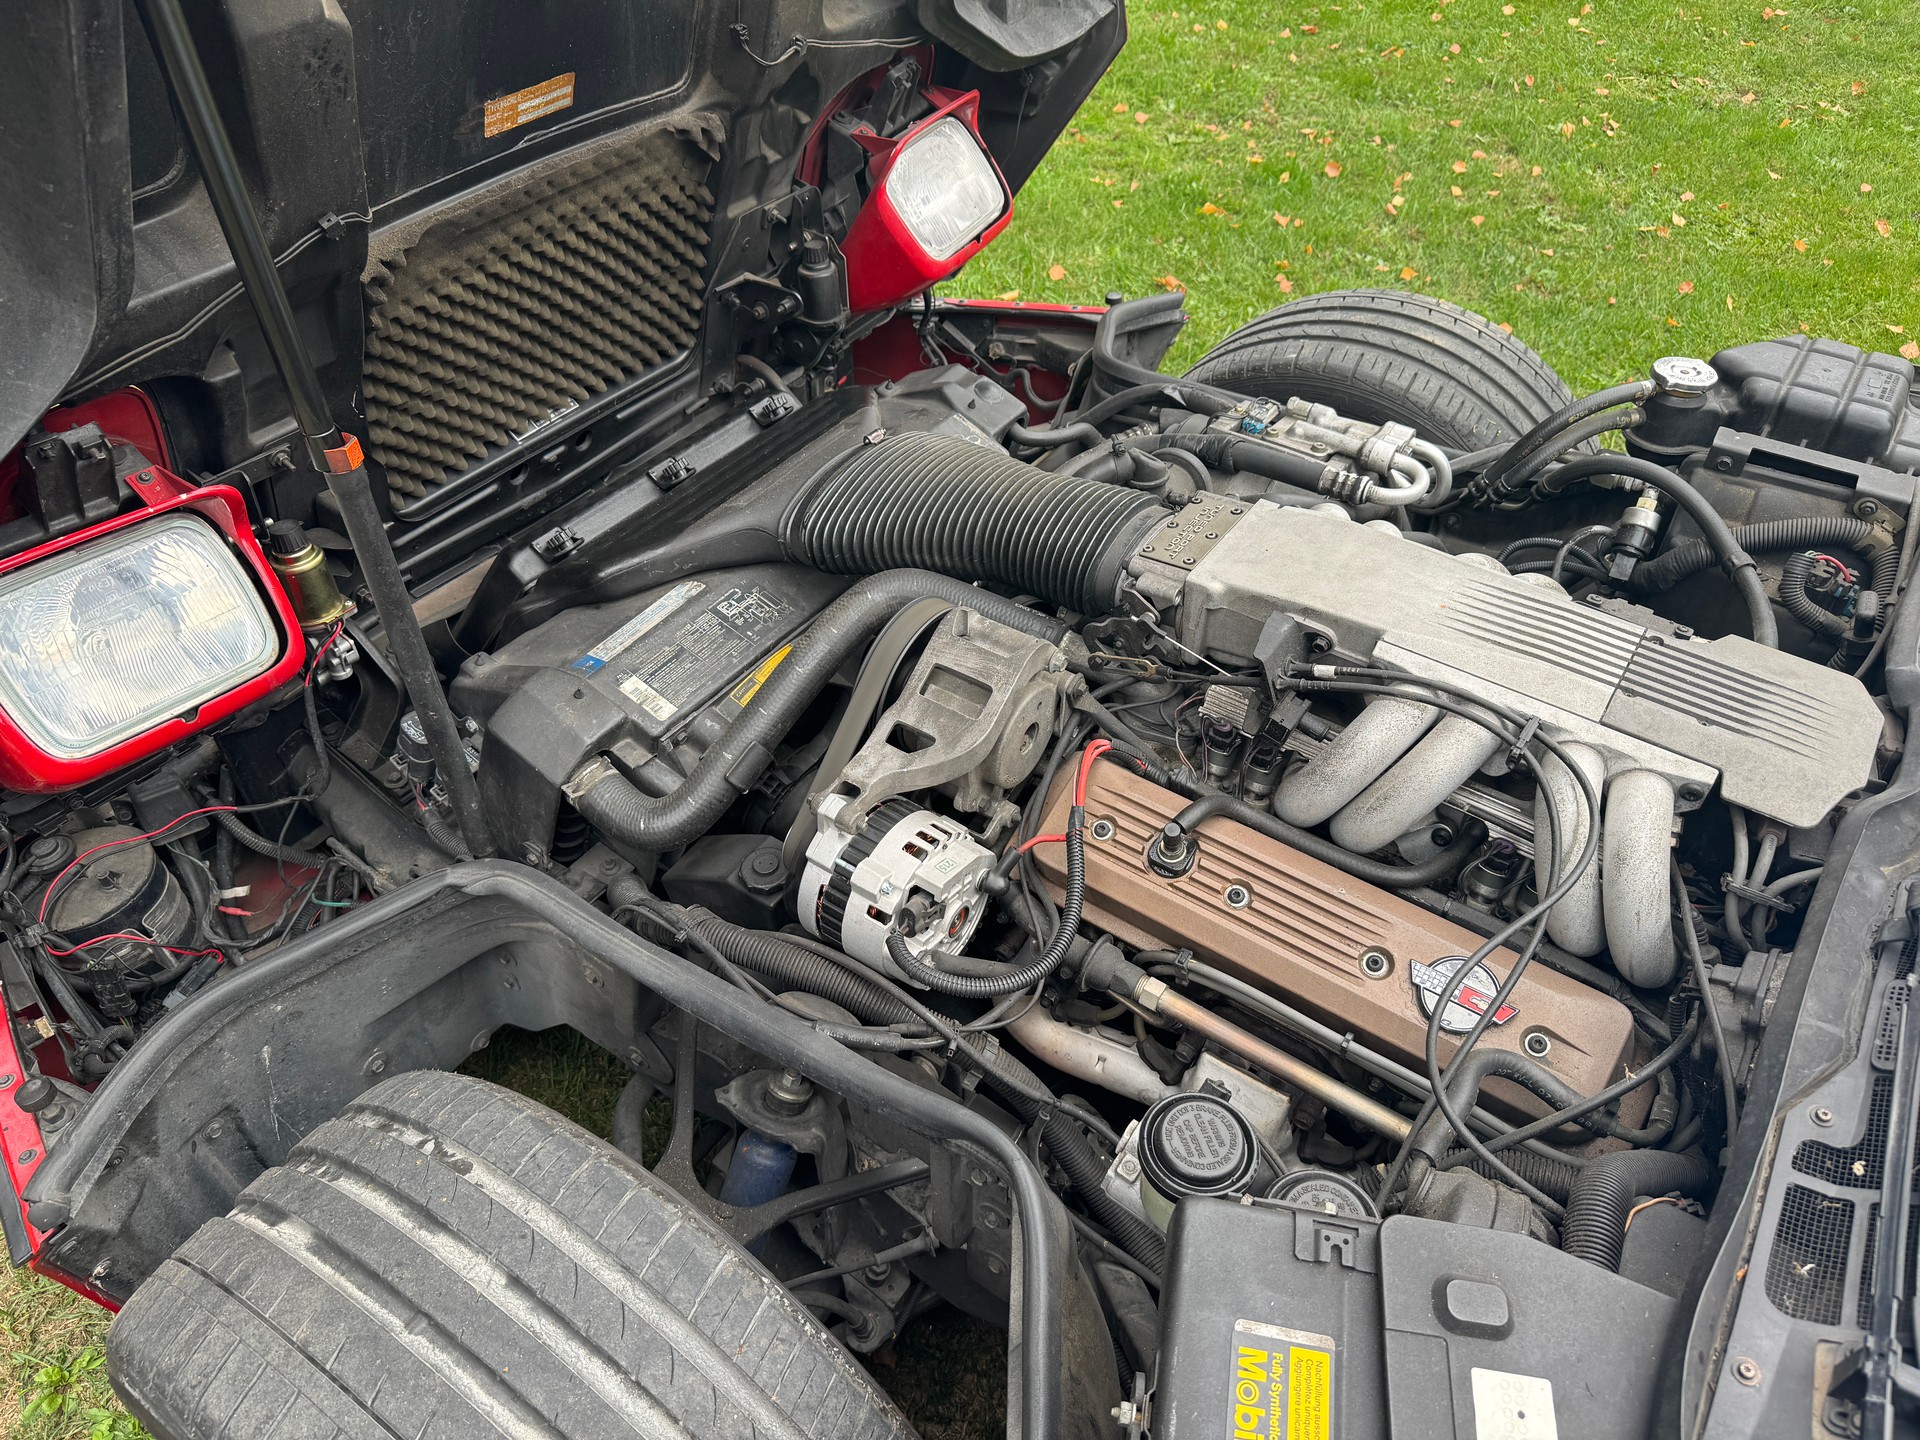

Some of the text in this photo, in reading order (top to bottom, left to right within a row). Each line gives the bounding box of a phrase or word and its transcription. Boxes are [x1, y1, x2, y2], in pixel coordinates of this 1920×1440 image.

[1164, 506, 1211, 551] INJECTION
[1169, 504, 1225, 560] TUNED PORT
[938, 860, 954, 872] 215
[1176, 1105, 1190, 1117] DOT
[1195, 1104, 1220, 1118] BRAKE
[1218, 1115, 1234, 1132] FLUID
[1174, 1124, 1195, 1159] REMOVING
[1182, 1119, 1206, 1160] CAP BEFORE
[1194, 1113, 1220, 1159] CLEAN FILLER
[1207, 1118, 1226, 1148] WARNING
[1228, 1131, 1237, 1151] FROM
[1205, 1154, 1231, 1171] SEALED
[1234, 1346, 1268, 1440] Mobi
[1268, 1352, 1284, 1440] Fully Synthetic
[1294, 1356, 1304, 1406] Aggiungere
[1304, 1358, 1314, 1405] Complétez
[1313, 1360, 1323, 1413] Nachfüllung
